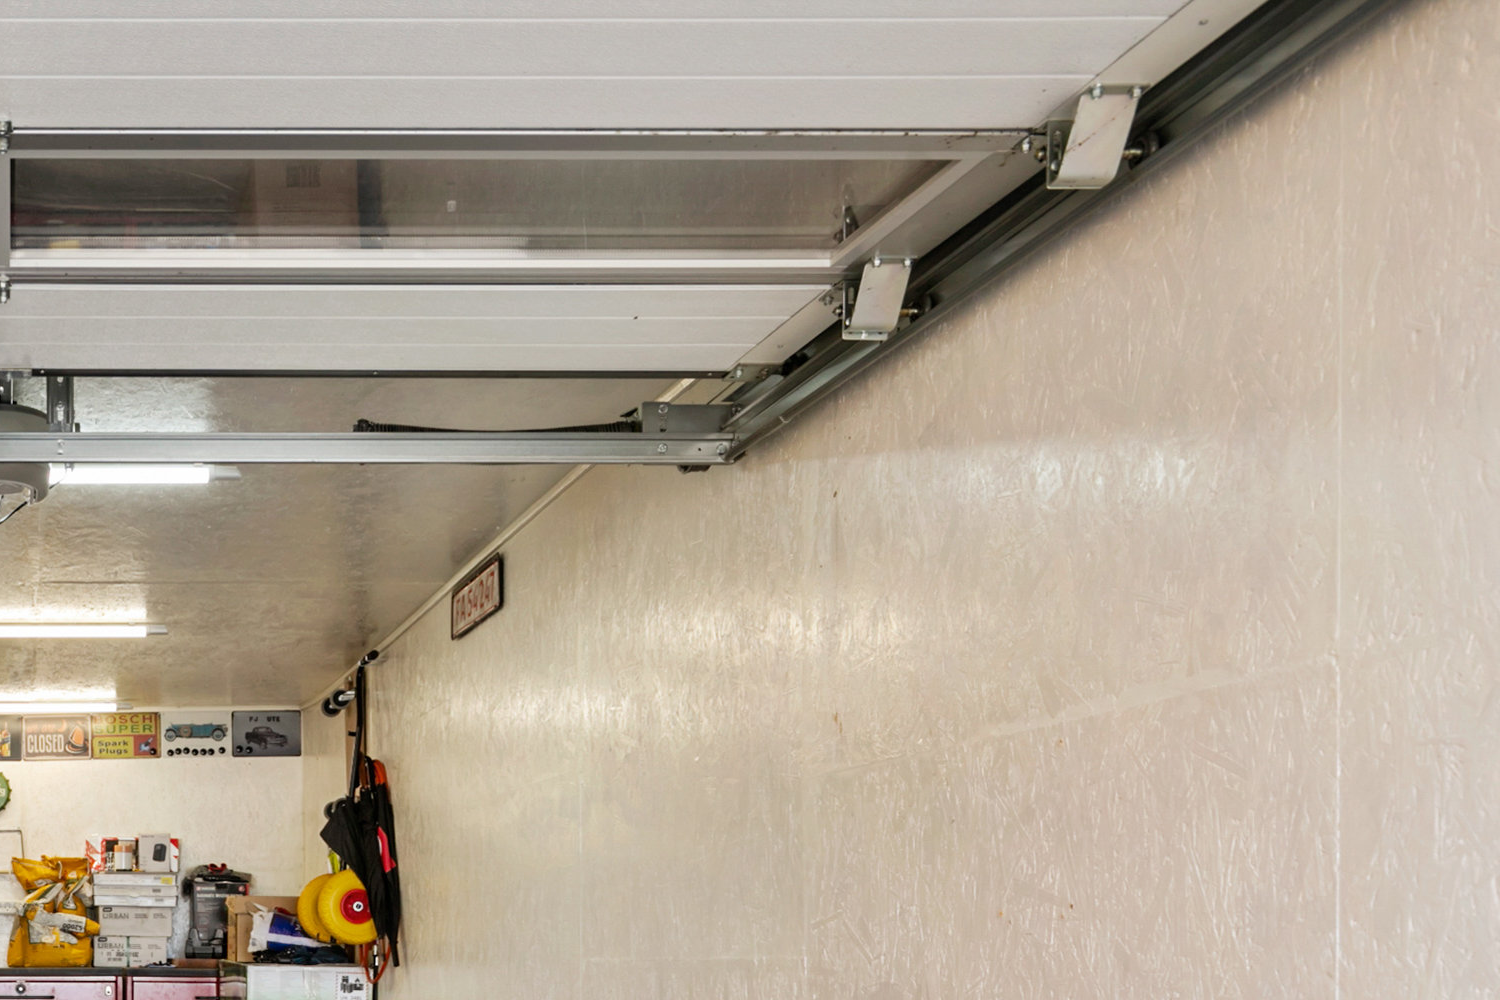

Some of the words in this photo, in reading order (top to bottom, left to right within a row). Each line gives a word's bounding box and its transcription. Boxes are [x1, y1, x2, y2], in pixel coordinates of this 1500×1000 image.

[93, 714, 153, 724] BOSCH
[93, 724, 154, 734] SUPER
[27, 734, 64, 753] CLOSED
[98, 740, 129, 748] Spark
[98, 747, 129, 755] Plugs
[102, 912, 130, 920] URBAN
[97, 942, 124, 950] URBAN
